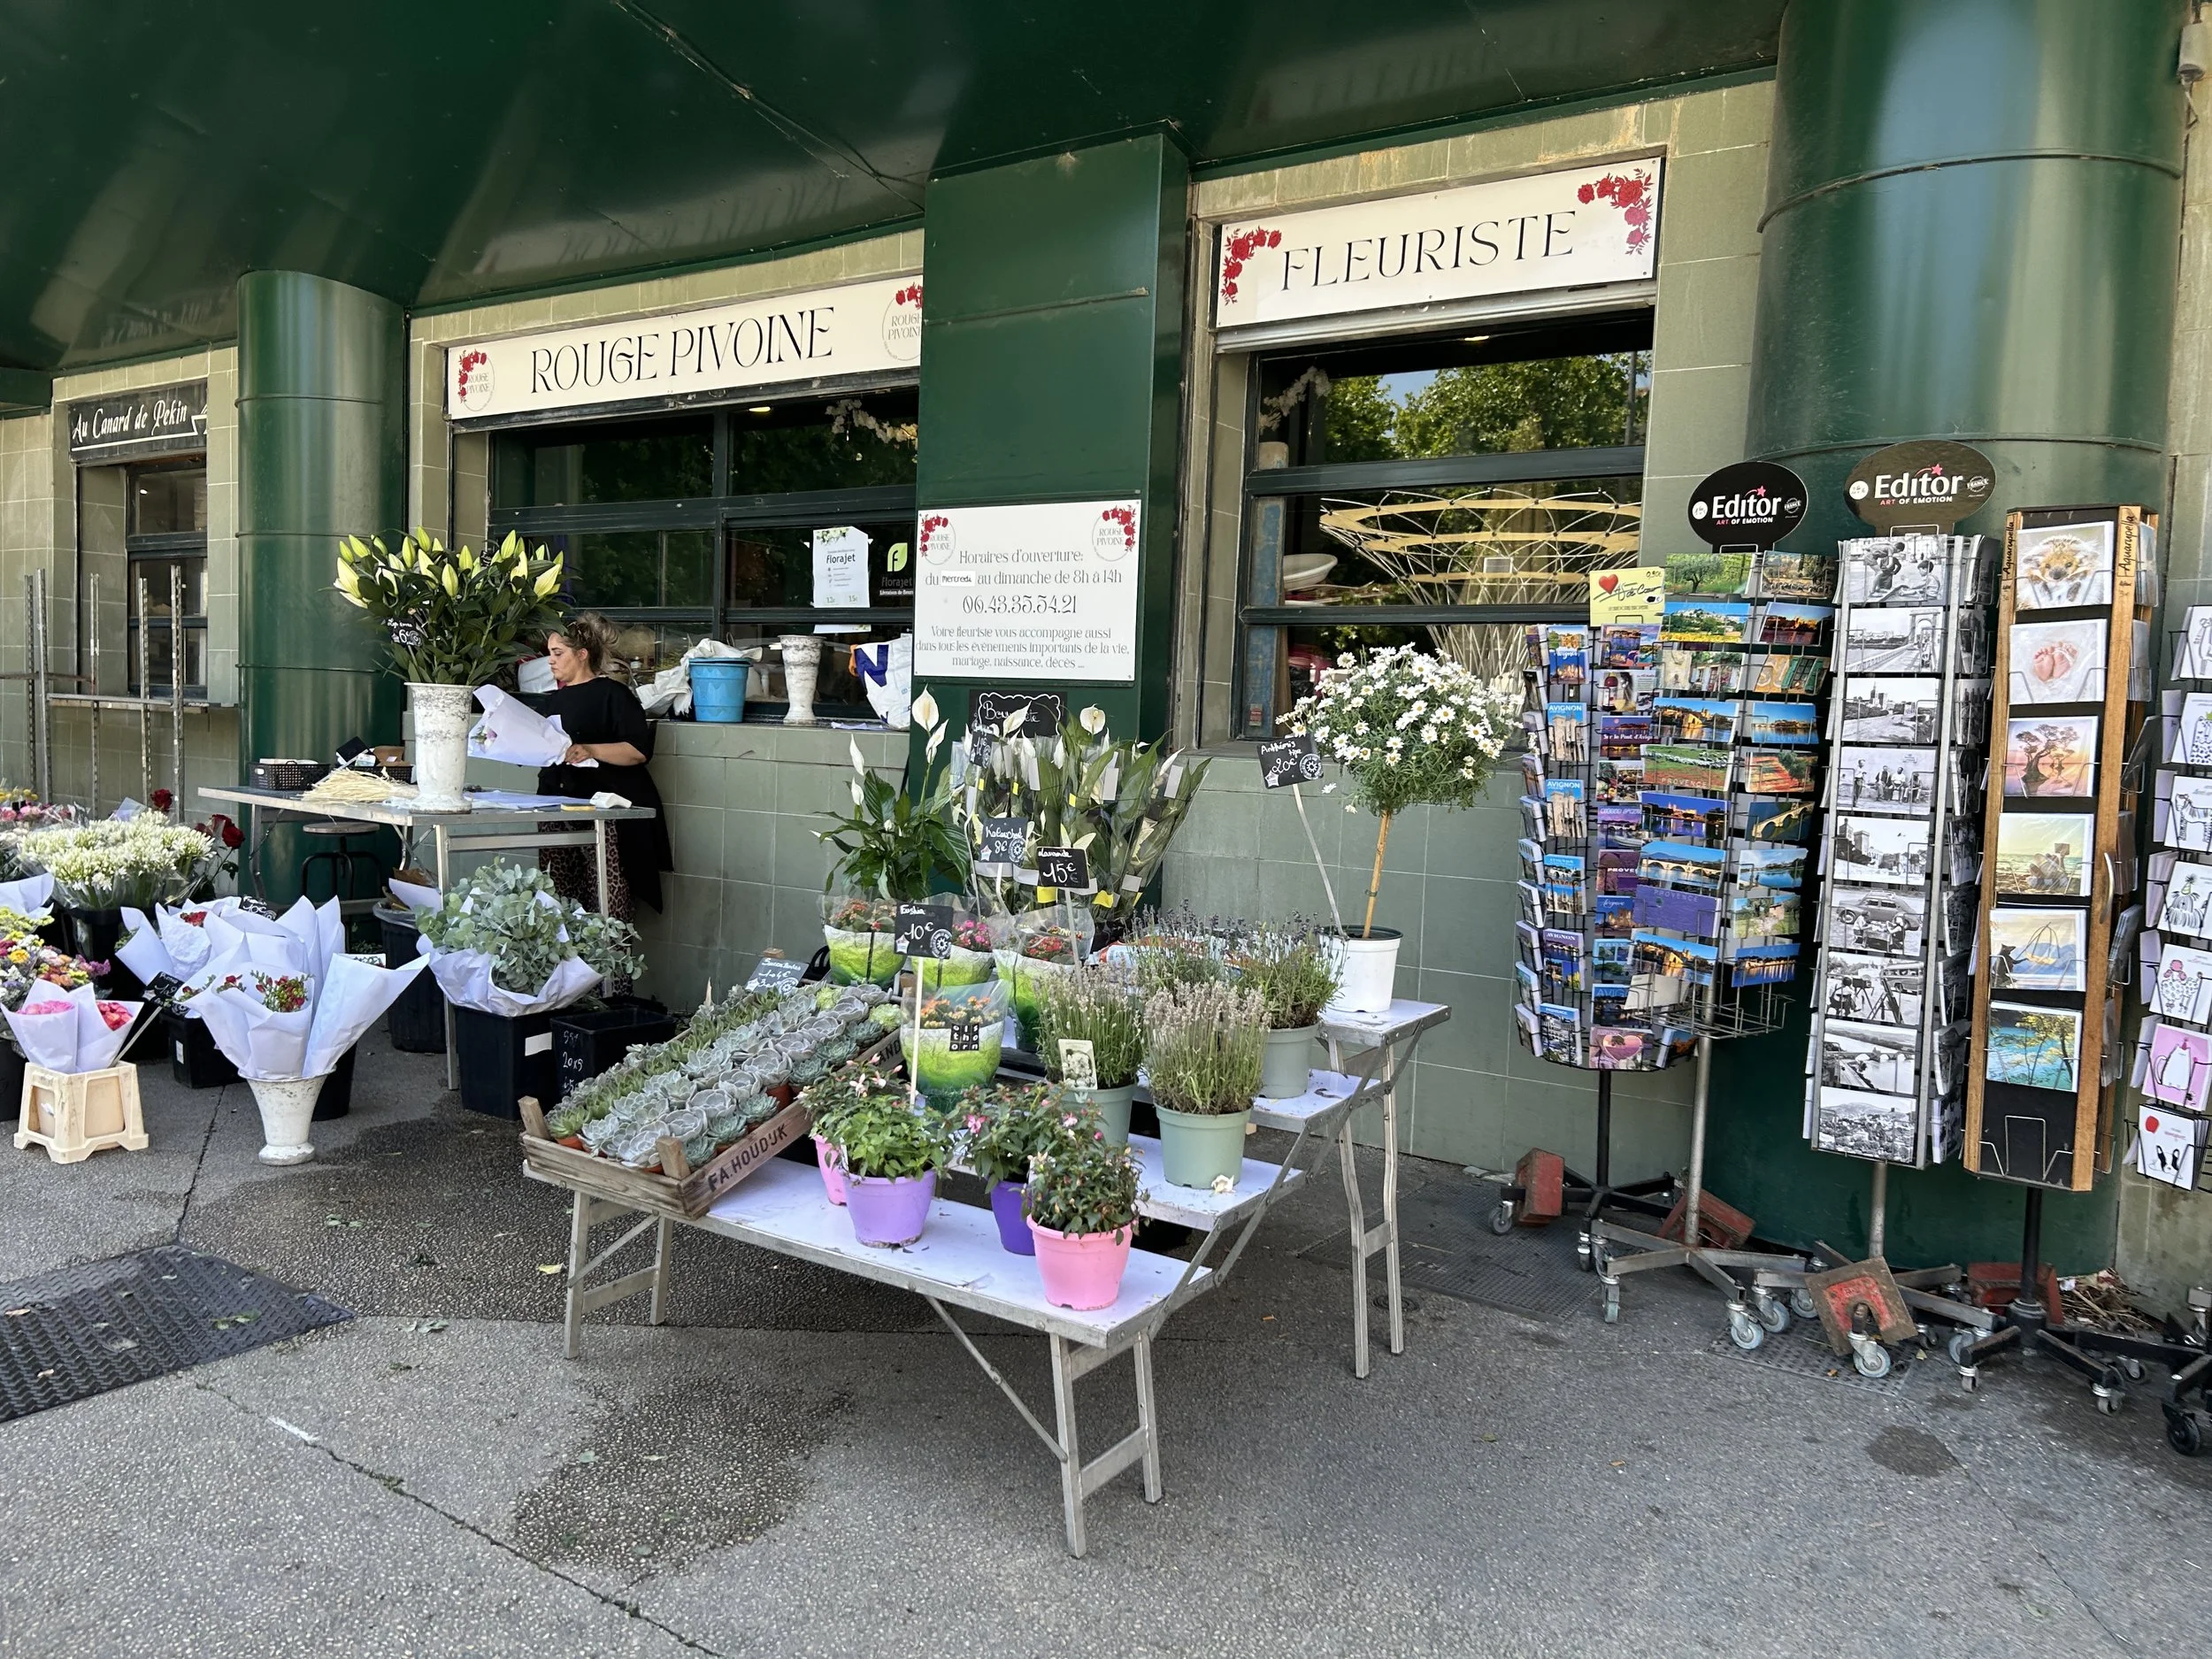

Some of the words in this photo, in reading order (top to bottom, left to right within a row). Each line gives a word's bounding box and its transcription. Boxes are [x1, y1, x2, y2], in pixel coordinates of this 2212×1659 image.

[1281, 210, 1576, 291] FLEURISTE
[531, 334, 660, 393] ROUGE
[671, 307, 834, 375] PIVOINE
[468, 373, 488, 384] ROUGE
[466, 383, 489, 395] PIVOINE
[73, 413, 88, 443] Au
[92, 406, 132, 439] Canard
[134, 404, 149, 429] de
[151, 400, 188, 435] Pekin
[1875, 472, 1963, 499] Editor
[1712, 495, 1782, 518] Editor
[929, 534, 950, 542] ROUGE
[1099, 527, 1124, 536] ROUGE
[927, 541, 951, 550] PIVOINE
[1096, 536, 1125, 546] PIVOINE
[826, 553, 856, 565] florajet
[959, 549, 1009, 565] Horaires
[1011, 549, 1084, 563] d'ouverture:
[881, 577, 912, 588] florajet
[926, 572, 939, 585] du
[978, 574, 990, 585] au
[994, 571, 1051, 585] dimanche
[1054, 570, 1071, 584] de
[1072, 570, 1089, 584] 8h
[1092, 571, 1100, 583] à
[1103, 569, 1122, 583] 14h
[963, 595, 1076, 614] 06.43.35.54.21
[931, 626, 955, 637] Votre
[956, 626, 993, 638] fleuriste
[995, 628, 1017, 638] vous
[1019, 628, 1083, 641] accompagne
[1085, 628, 1111, 638] aussi
[916, 641, 936, 651] dans
[956, 641, 970, 651] les
[1029, 642, 1082, 657] importants
[1085, 642, 1098, 653] de
[1100, 641, 1110, 653] la
[1662, 778, 1708, 788] PROVENCE
[1042, 862, 1077, 883] 15€
[1654, 889, 1698, 902] PROVENCE
[904, 922, 934, 940] 10€
